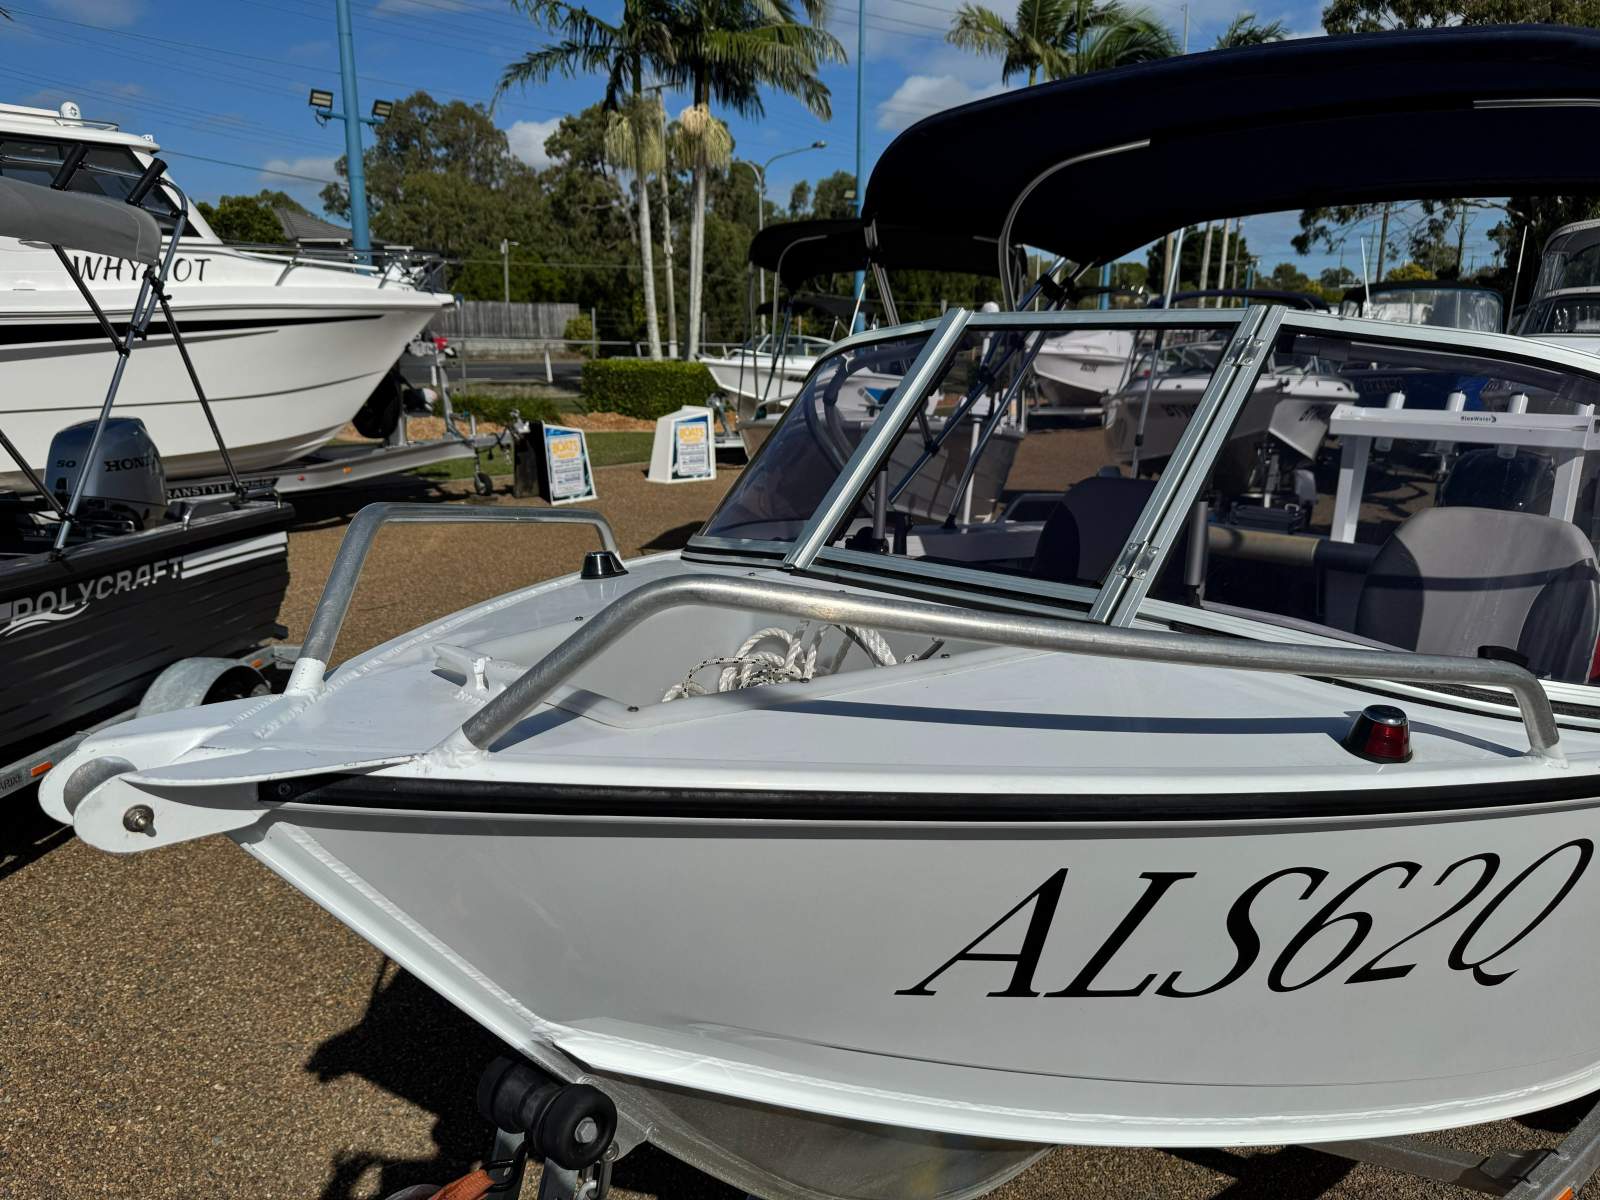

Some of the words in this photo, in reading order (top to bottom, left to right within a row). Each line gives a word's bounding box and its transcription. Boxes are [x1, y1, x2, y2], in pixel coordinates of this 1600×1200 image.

[73, 256, 141, 281] WHY
[56, 459, 77, 468] 50
[9, 556, 184, 625] POLYCRAFT
[895, 837, 1595, 999] ALS62Q
